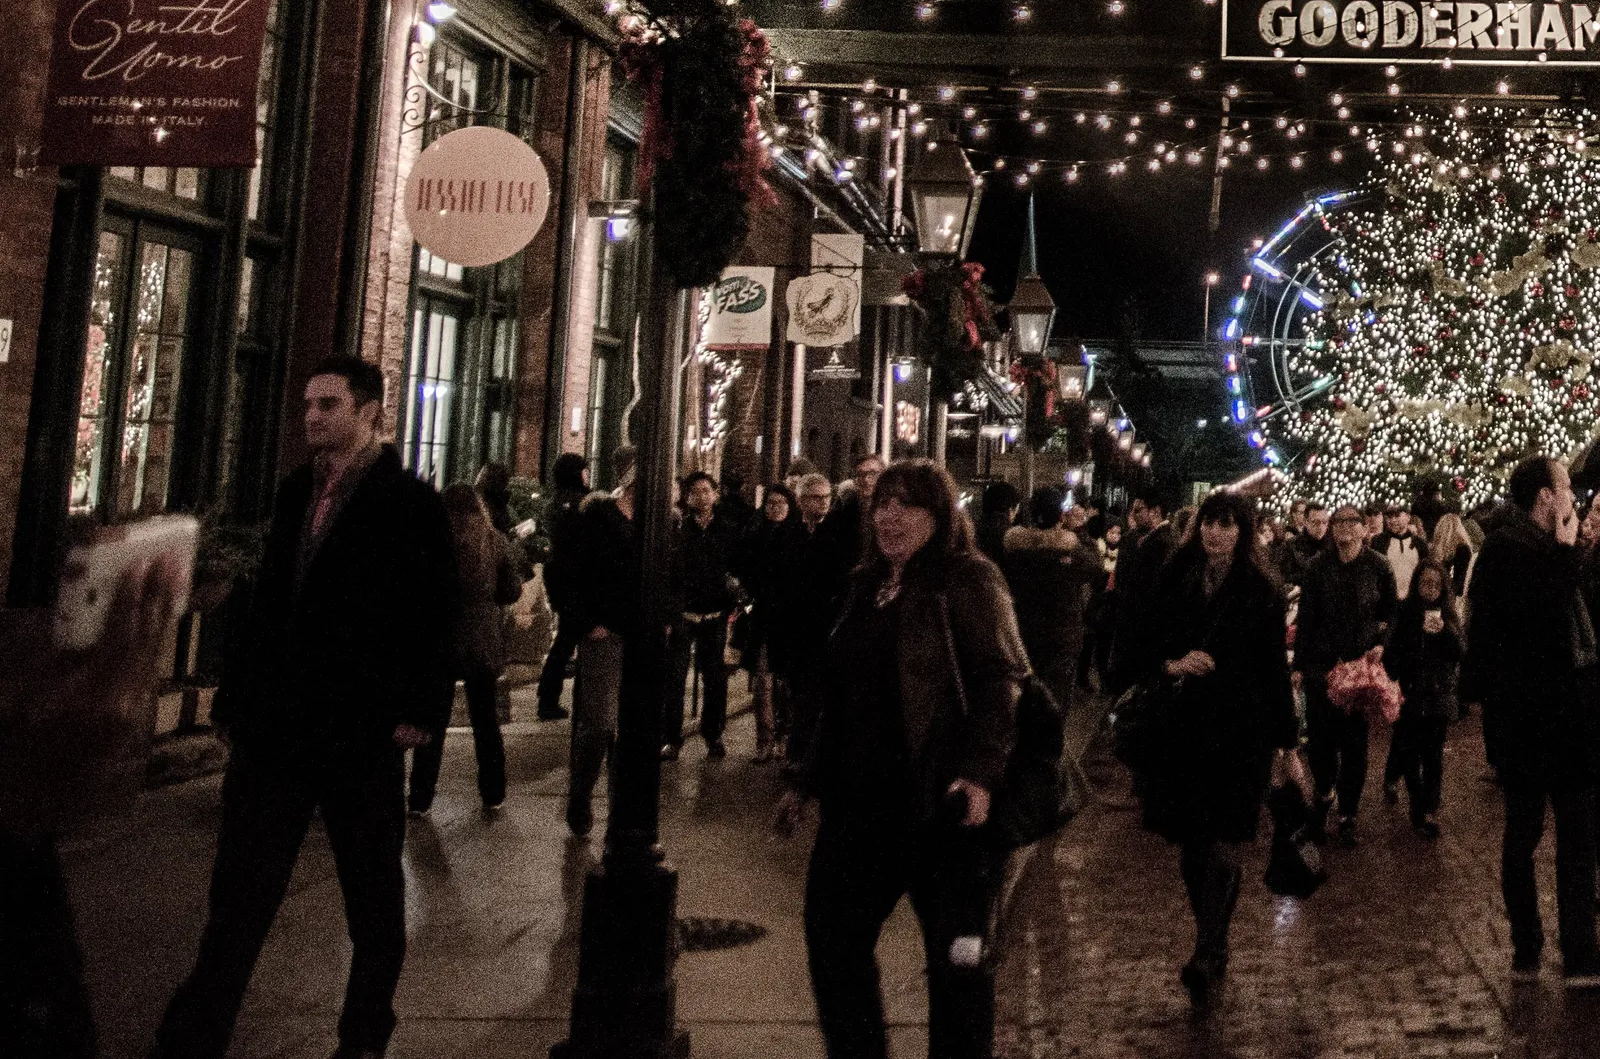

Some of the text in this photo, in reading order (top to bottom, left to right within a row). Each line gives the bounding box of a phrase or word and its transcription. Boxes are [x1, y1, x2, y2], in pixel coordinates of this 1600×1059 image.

[82, 41, 244, 81] Uomo
[57, 95, 240, 108] GENTLEMAN'S FASHION
[92, 115, 135, 126] MADE
[716, 280, 761, 313] FASS
